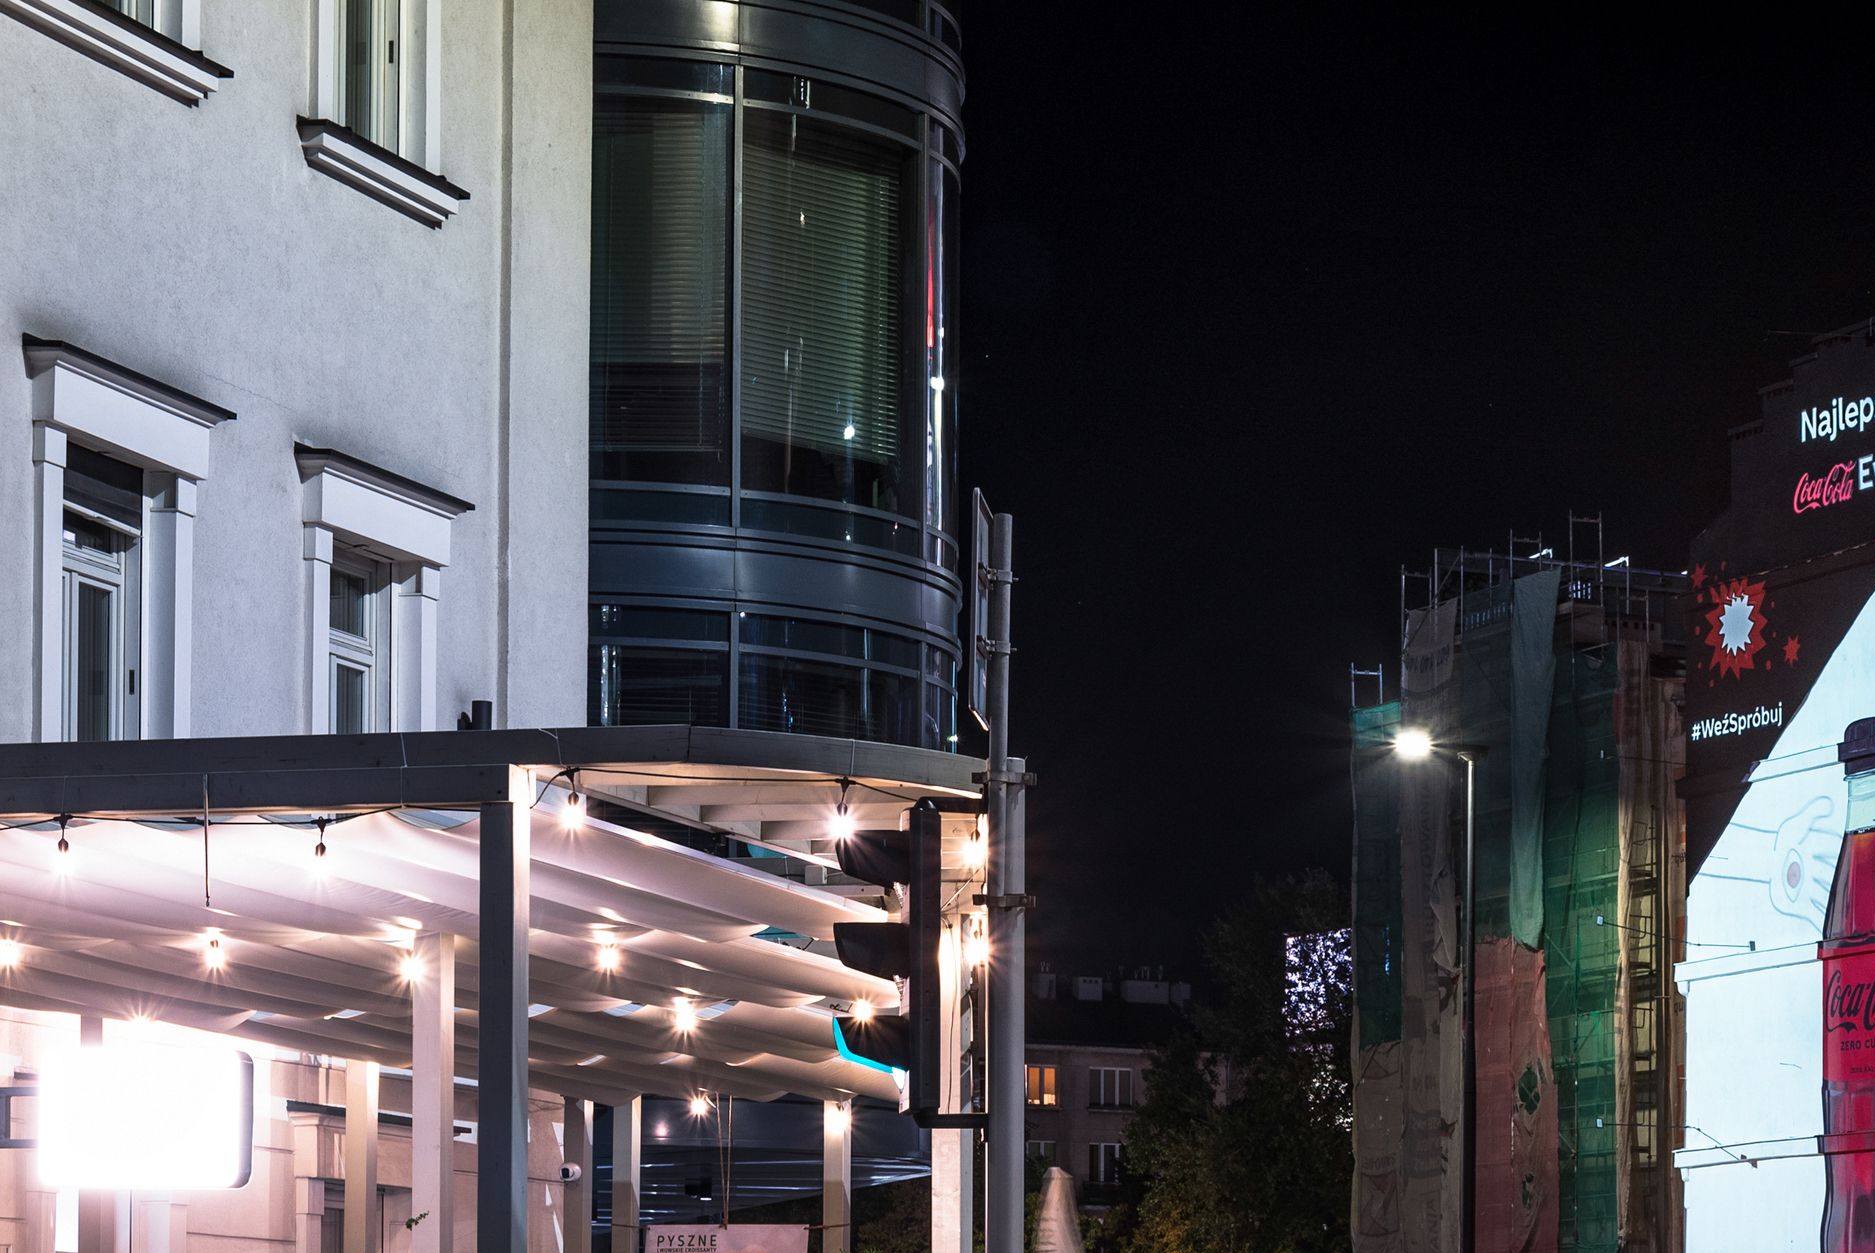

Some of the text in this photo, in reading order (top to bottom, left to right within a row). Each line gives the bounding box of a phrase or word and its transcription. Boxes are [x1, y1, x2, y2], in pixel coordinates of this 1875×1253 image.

[1793, 460, 1856, 514] Coca-Cola
[1691, 701, 1783, 742] #WeźSpróbuj
[1840, 1039, 1861, 1051] ZERO
[656, 1234, 717, 1247] PYSZNE
